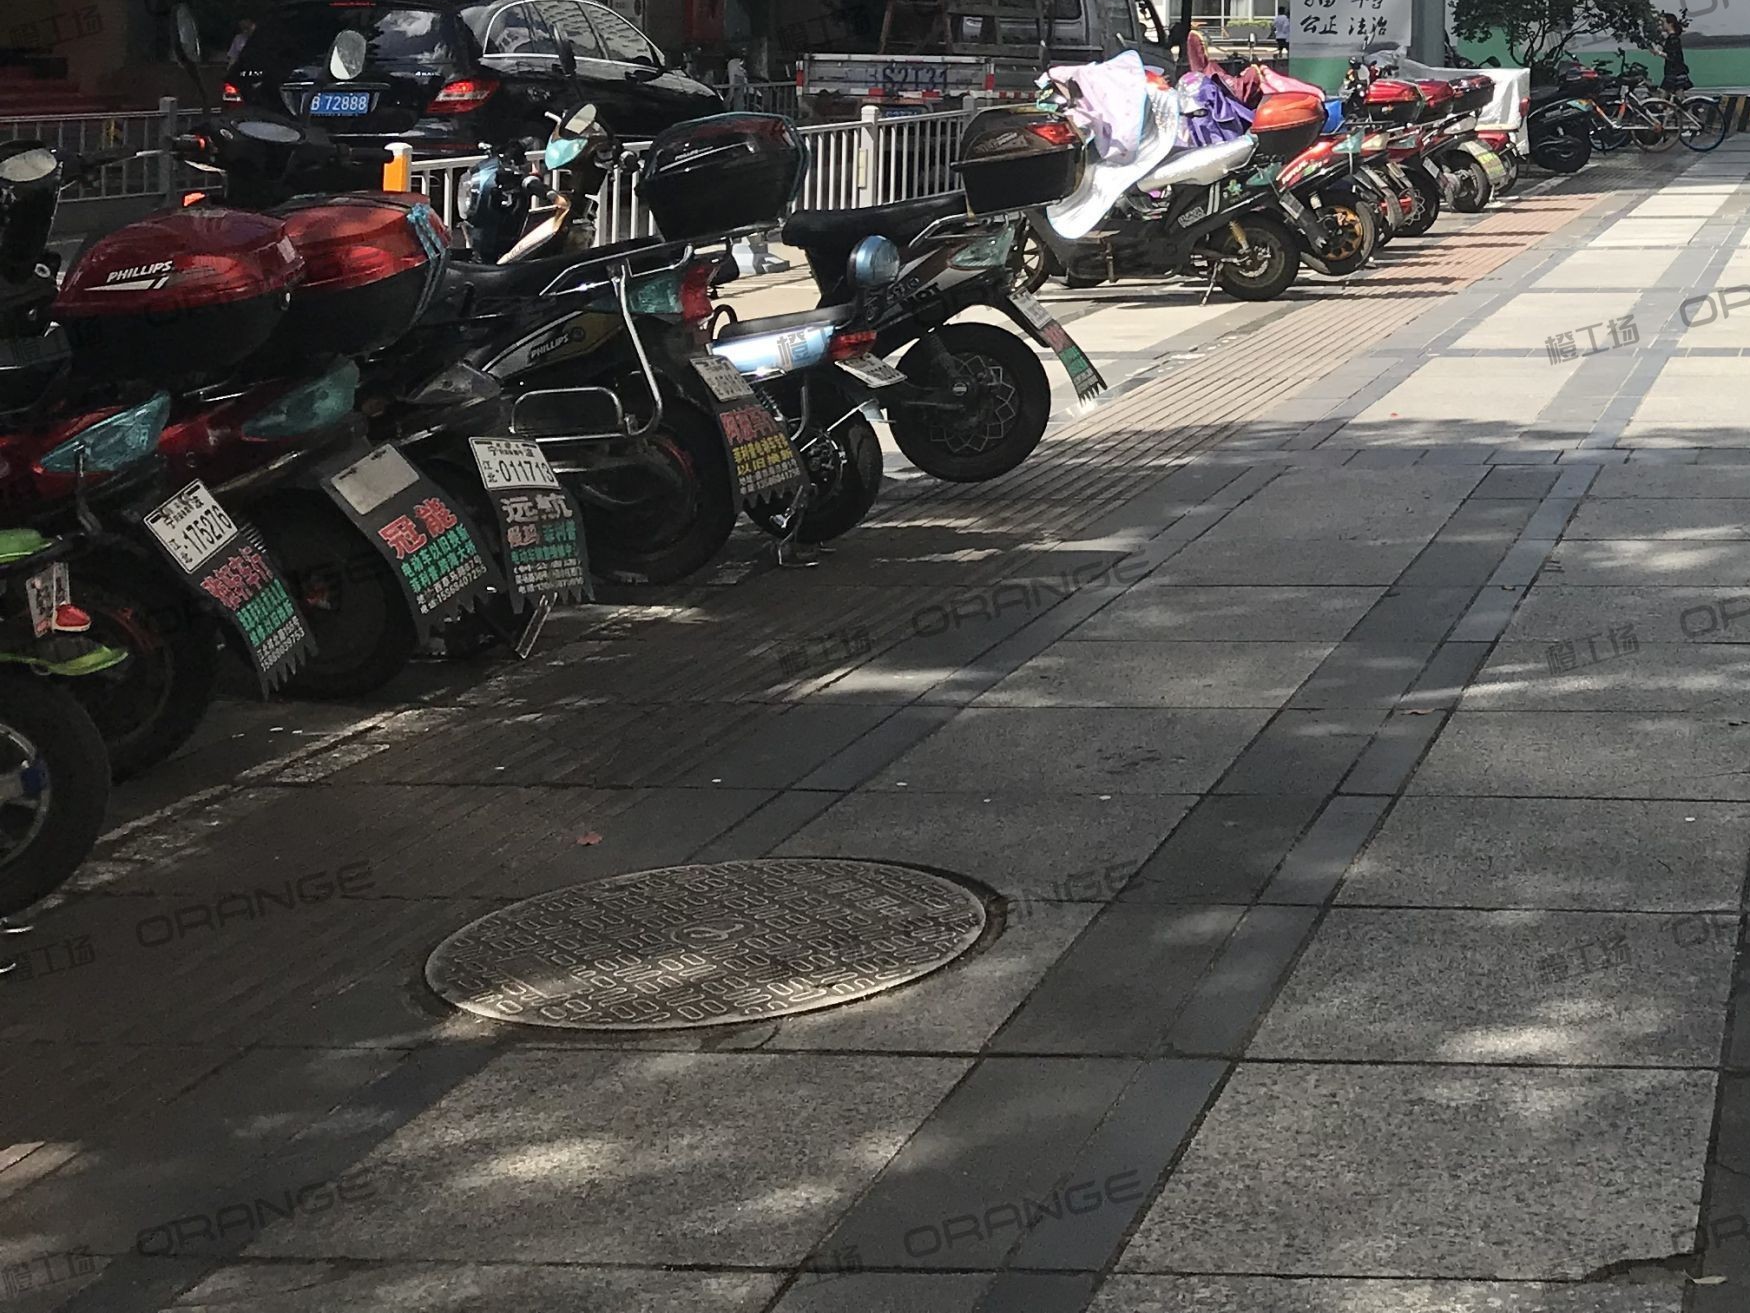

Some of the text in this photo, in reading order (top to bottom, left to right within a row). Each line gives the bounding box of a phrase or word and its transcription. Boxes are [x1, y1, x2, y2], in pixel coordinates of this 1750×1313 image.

[1300, 14, 1389, 37] 公正 法治
[106, 260, 174, 283] PHILLIPS
[530, 333, 569, 359] PHILLIPS
[500, 494, 573, 524] 远航
[378, 497, 459, 560] 冠能
